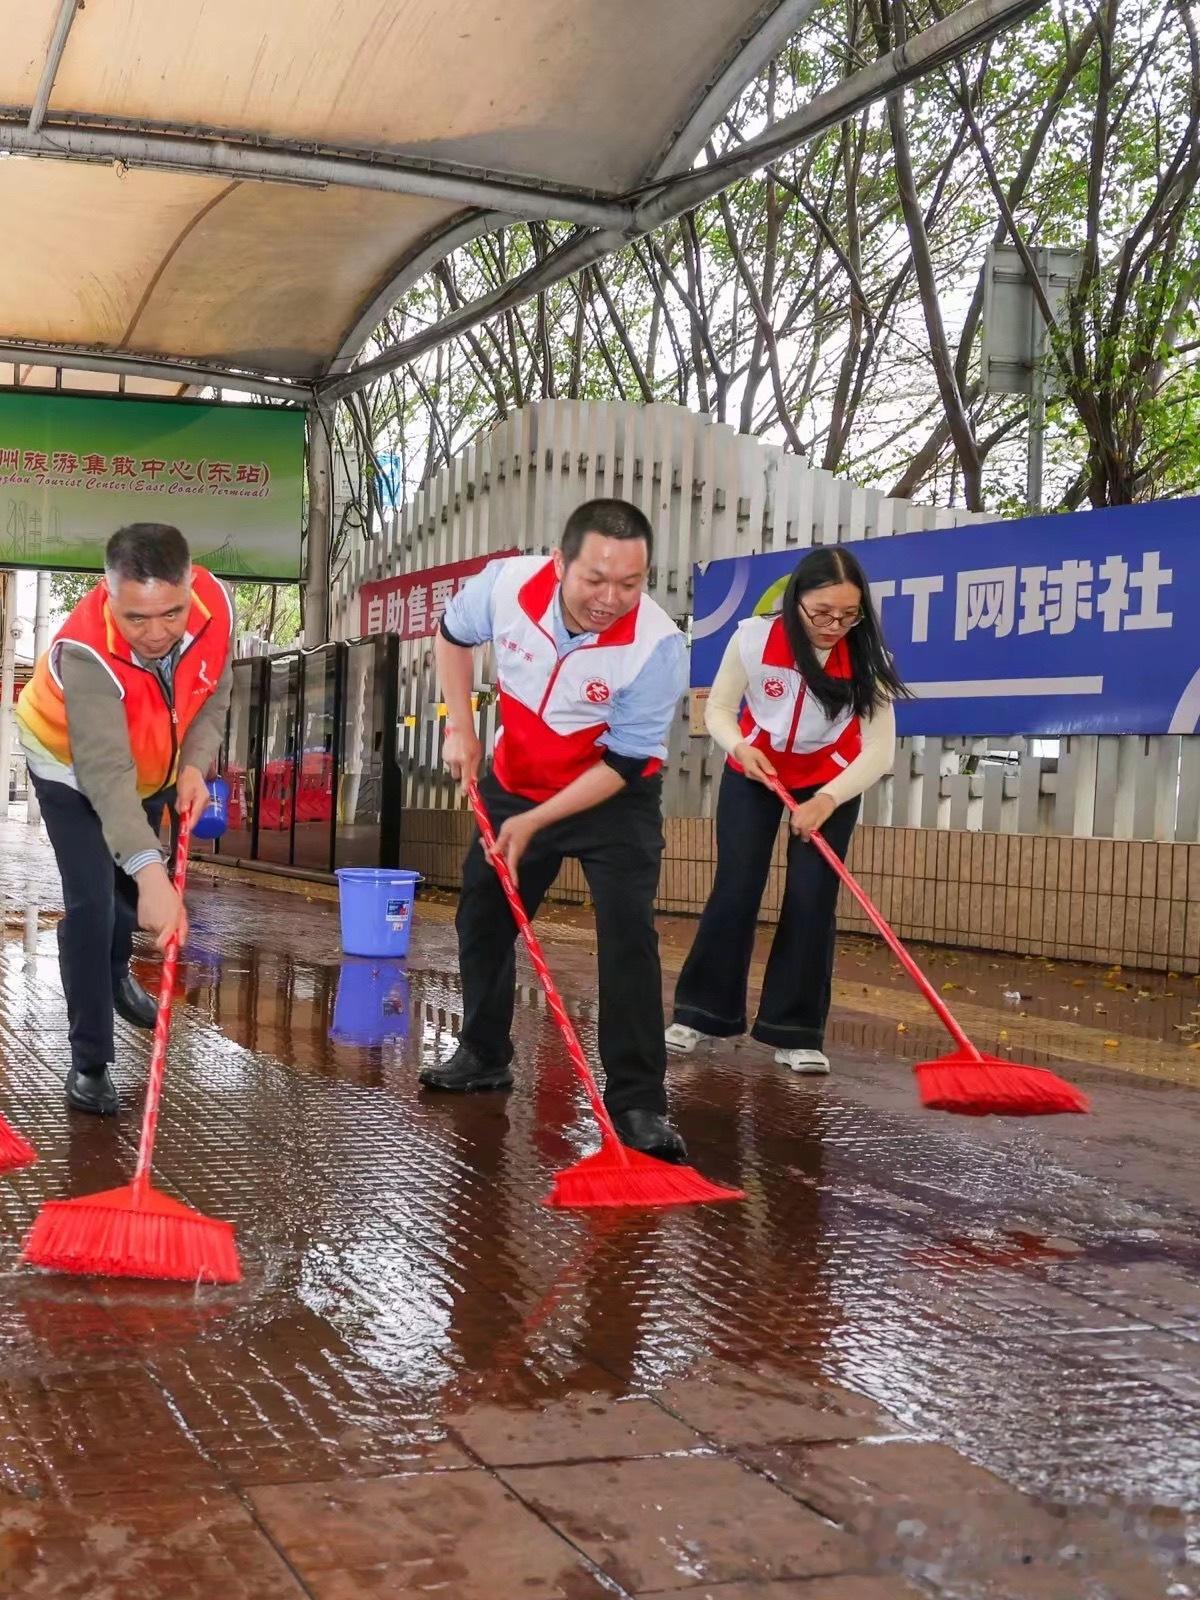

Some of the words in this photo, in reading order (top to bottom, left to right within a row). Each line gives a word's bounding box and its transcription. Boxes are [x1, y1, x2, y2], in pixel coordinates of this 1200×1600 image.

[36, 474, 82, 488] Tourist
[168, 482, 204, 494] Coach
[209, 484, 269, 497] Terminal)
[368, 577, 474, 635] 自助售票
